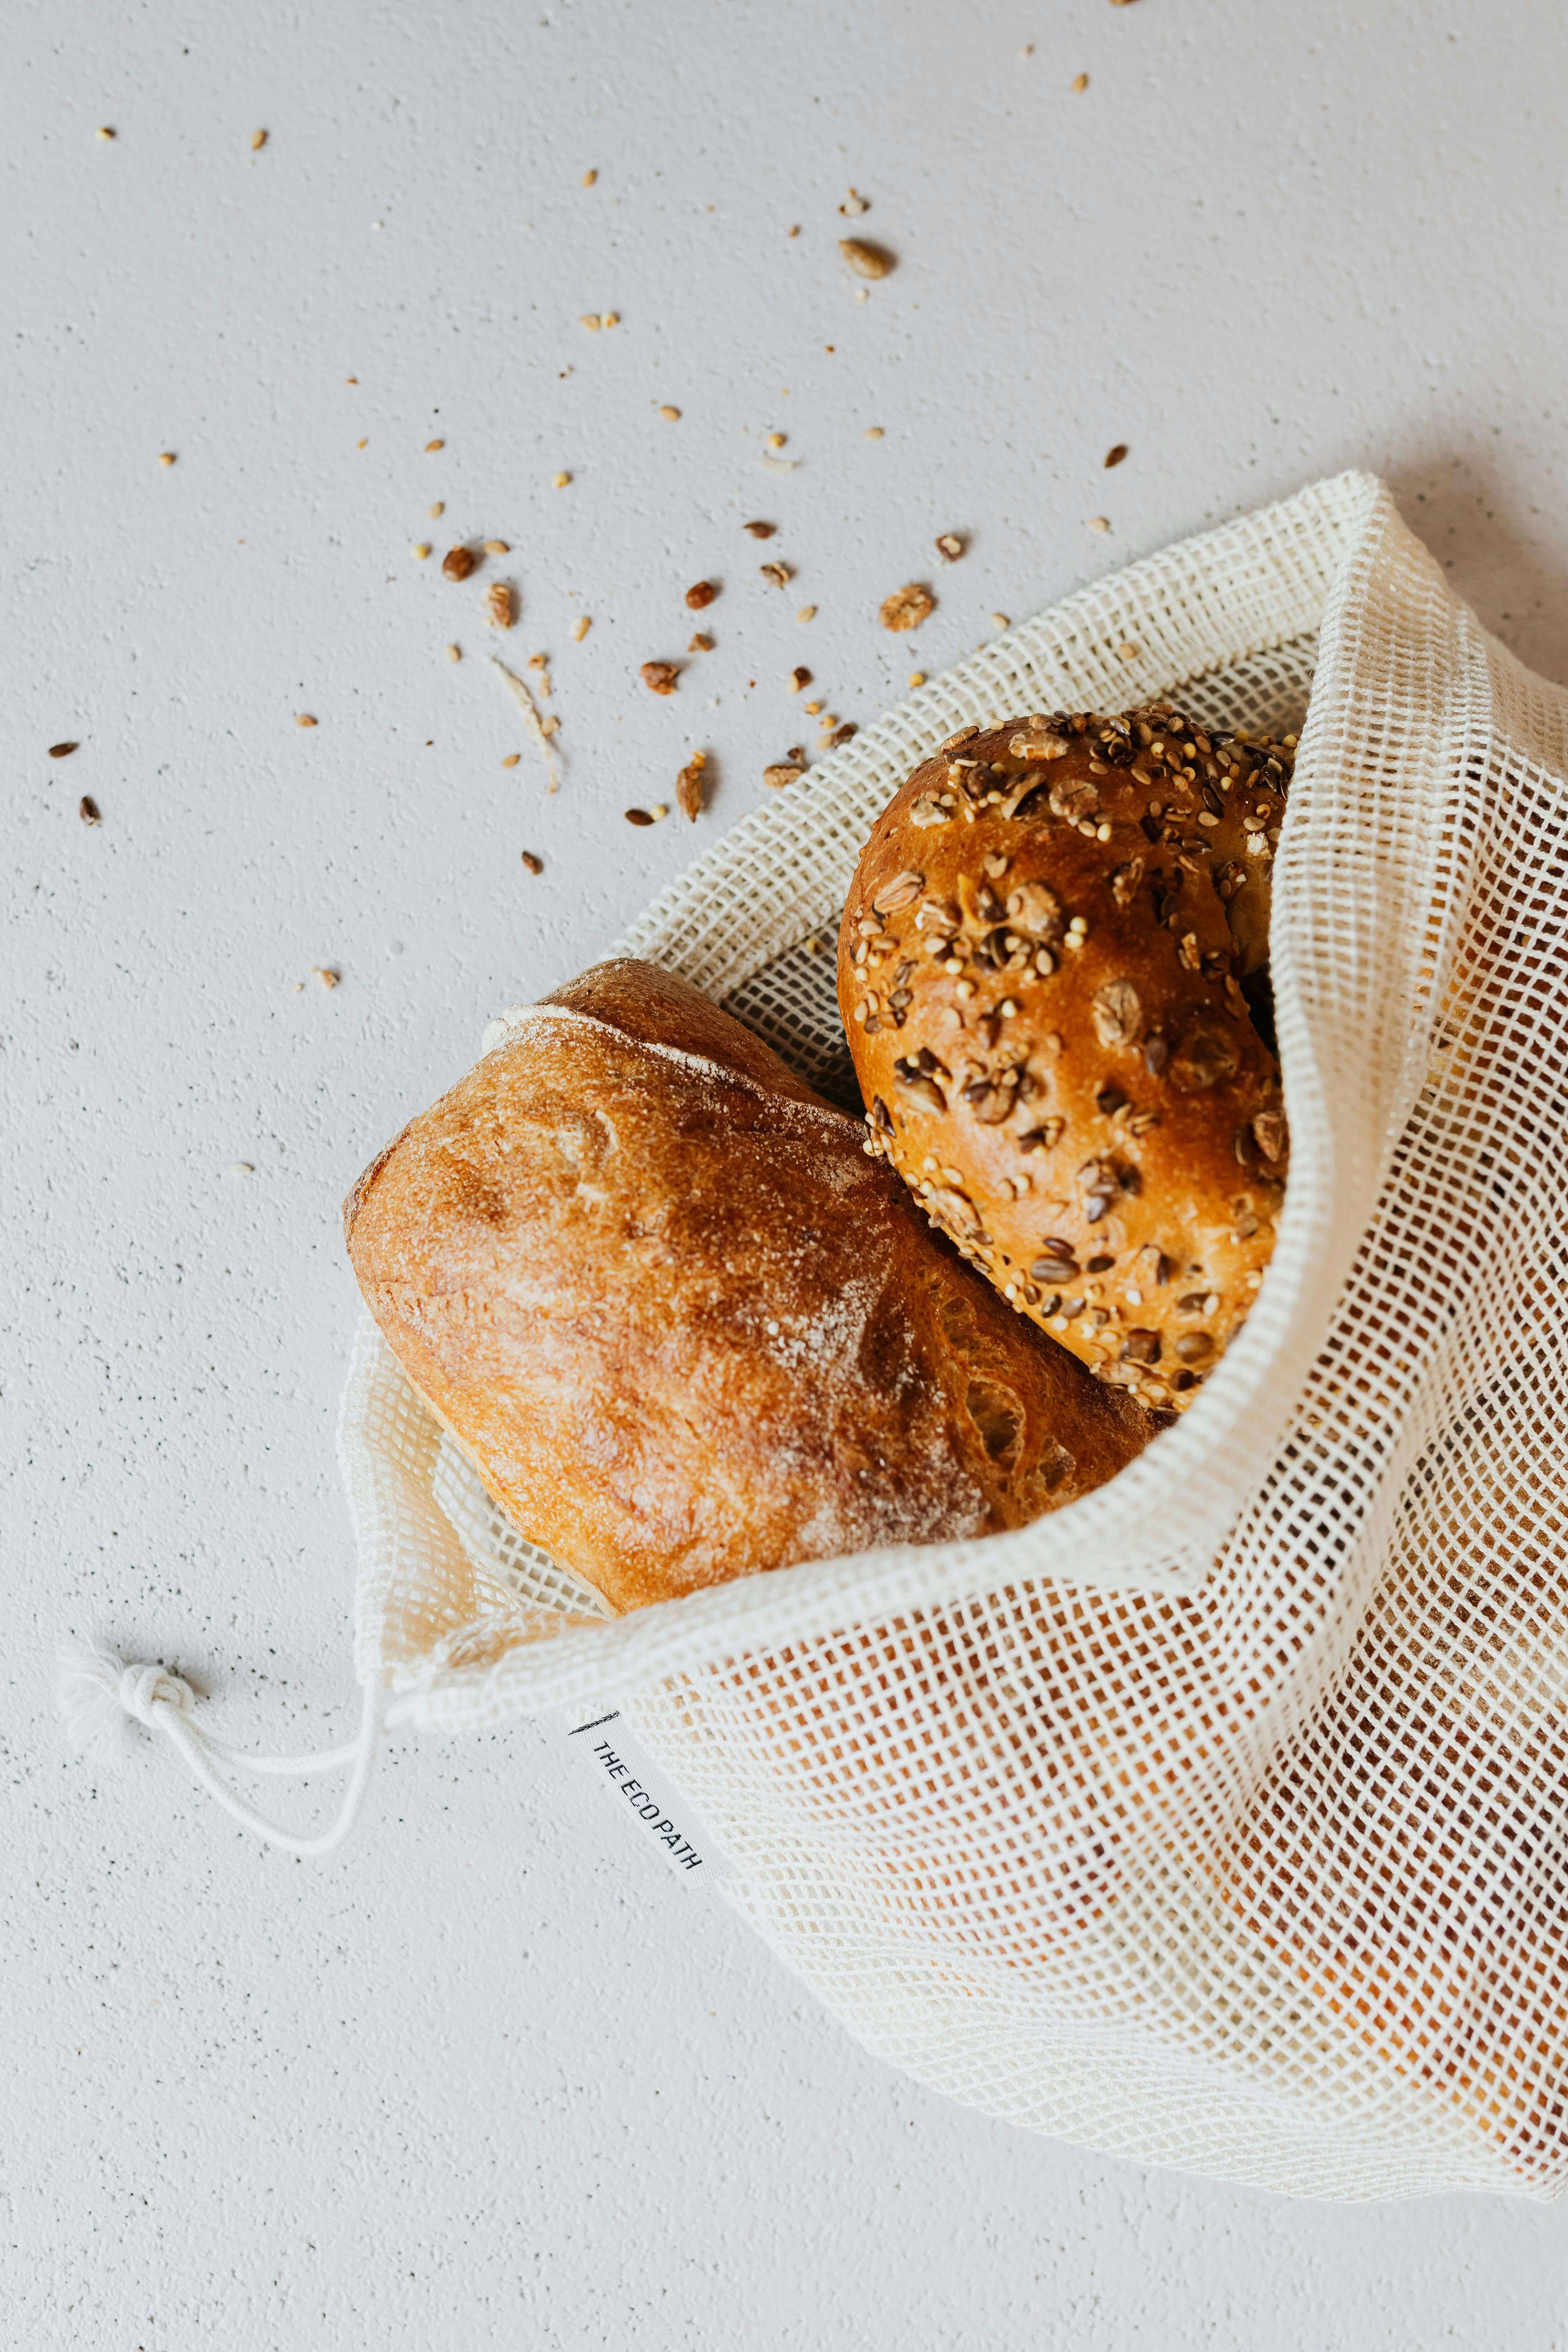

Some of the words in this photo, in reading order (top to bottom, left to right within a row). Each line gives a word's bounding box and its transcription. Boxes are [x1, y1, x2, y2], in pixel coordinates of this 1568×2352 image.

[594, 1740, 630, 1780] THE
[620, 1779, 660, 1820] ECO
[652, 1819, 703, 1870] PATH
